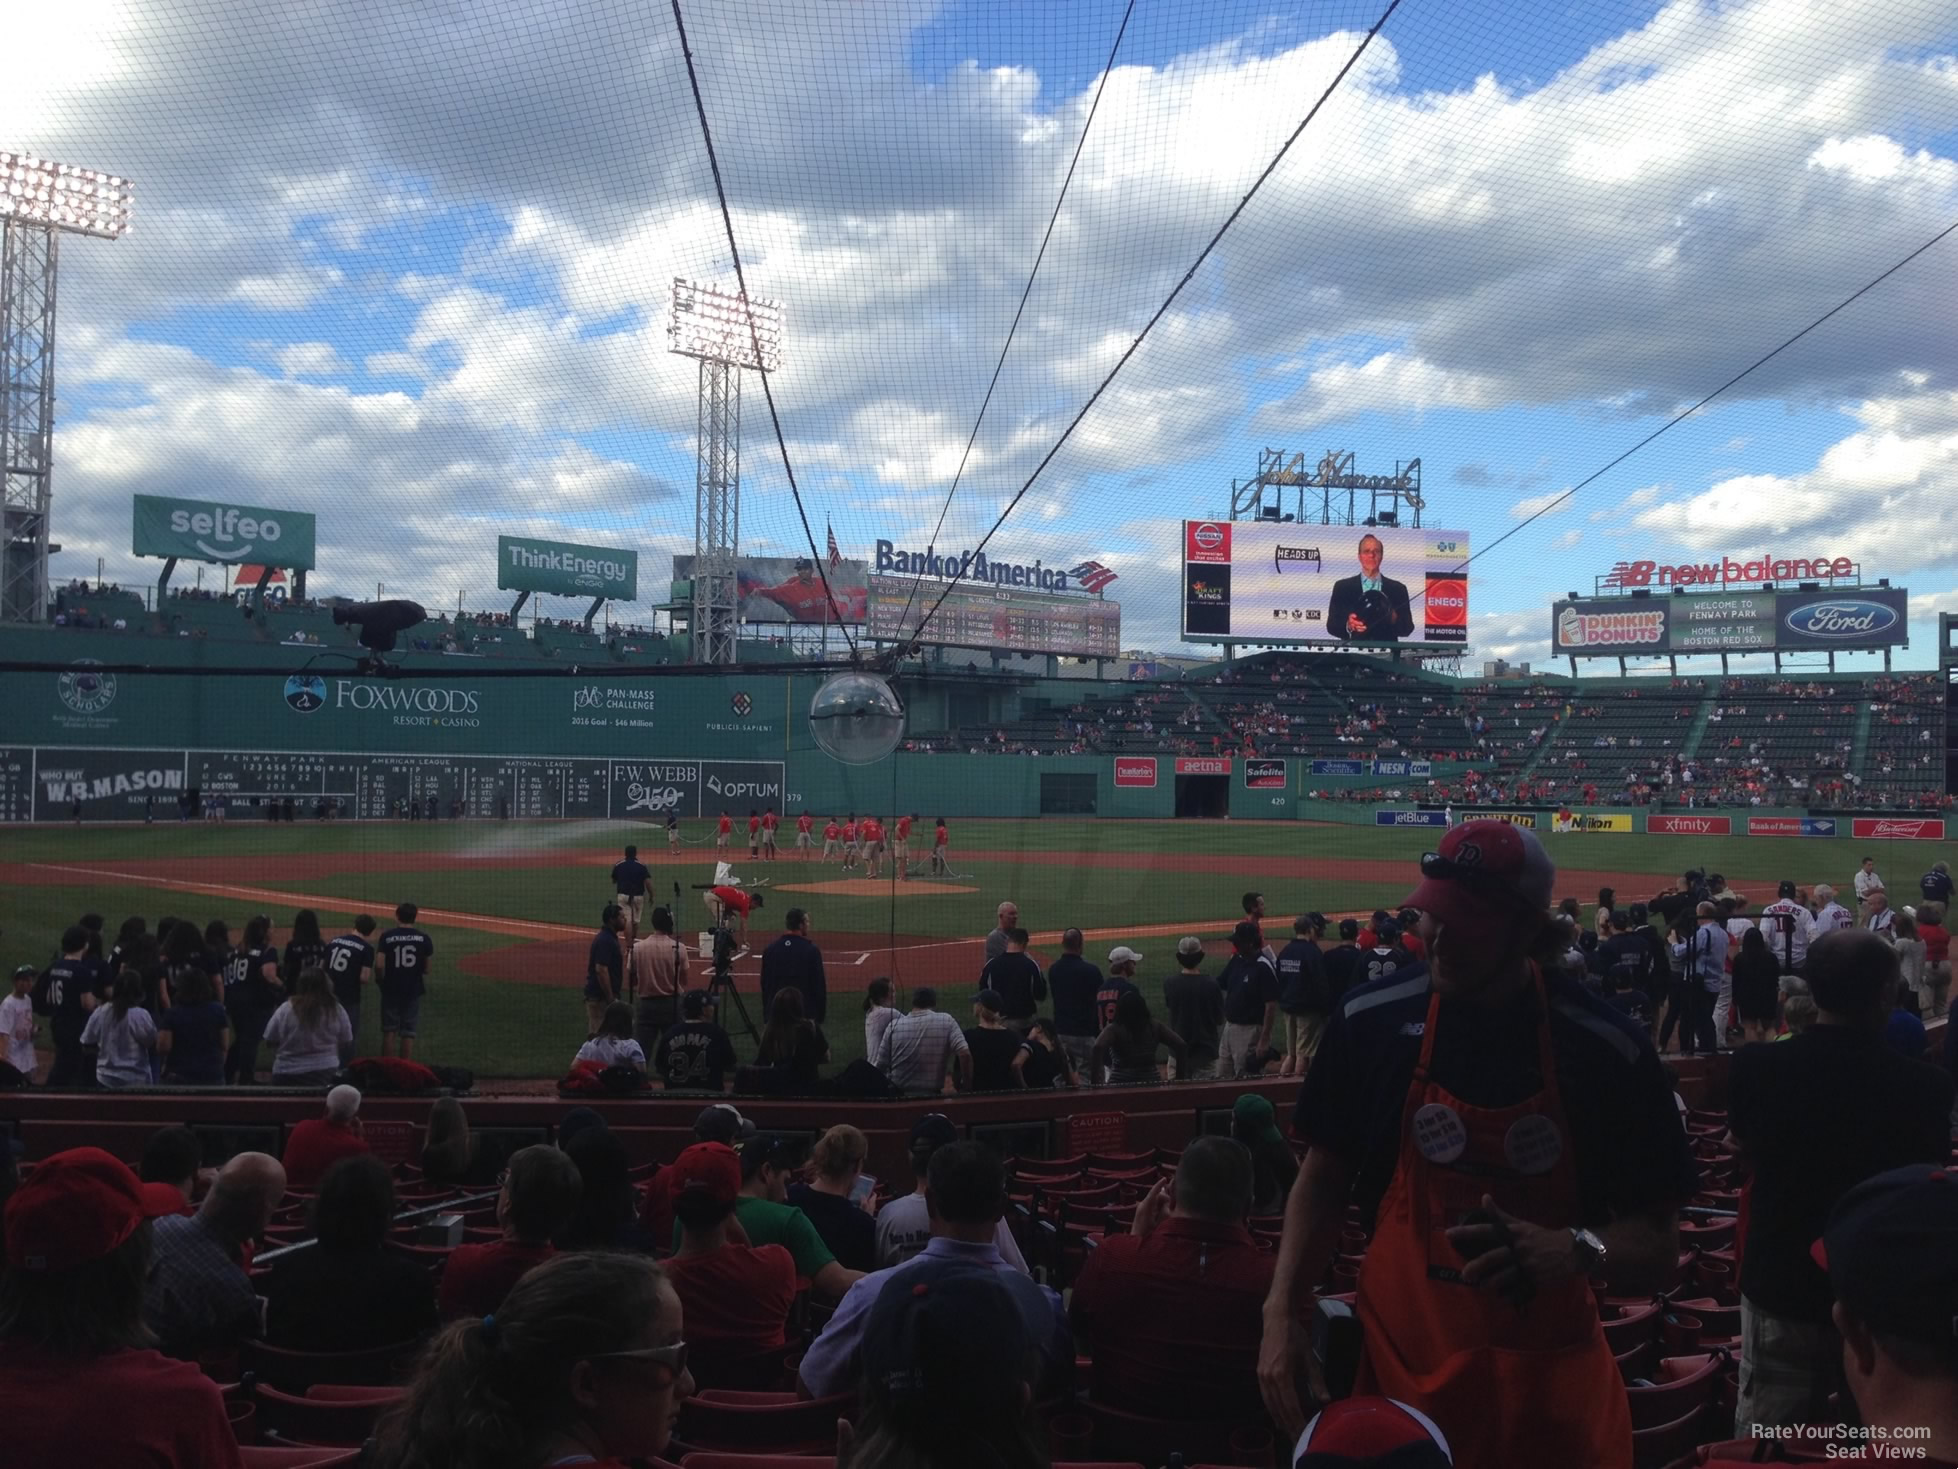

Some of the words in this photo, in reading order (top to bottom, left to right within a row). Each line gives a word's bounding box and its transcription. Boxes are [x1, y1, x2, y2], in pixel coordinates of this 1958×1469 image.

[1277, 549, 1306, 559] HEADS
[1308, 550, 1319, 559] UP
[508, 546, 626, 581] ThinkEnergy
[876, 539, 941, 578] Bank
[944, 550, 971, 580] of
[973, 551, 1067, 591] America
[1659, 563, 1719, 586] new
[1723, 554, 1852, 582] balance
[1427, 597, 1464, 607] ENEOS
[1694, 601, 1738, 610] WELCOME
[1741, 600, 1753, 608] TO
[1306, 610, 1320, 619] CDC
[1689, 610, 1728, 620] FENWAY
[1731, 609, 1757, 618] PARK
[1808, 605, 1876, 632] Ford
[1588, 612, 1663, 630] DUNKIN'
[1588, 627, 1659, 643] DONUTS
[1691, 627, 1716, 635] HOME
[1720, 626, 1733, 635] OF
[1735, 626, 1755, 634] THE
[1684, 637, 1720, 645] BOSTON
[1723, 636, 1741, 644] RED
[1744, 636, 1762, 644] SOX
[607, 689, 655, 700] PAN-MASS
[606, 700, 654, 710] CHALLENGE
[393, 716, 431, 726] RESORT
[441, 718, 480, 727] CASINO
[571, 717, 590, 726] 2016
[591, 717, 607, 726] Goal
[630, 720, 654, 728] Million
[706, 723, 740, 731] PUBLICIS
[742, 724, 773, 732] SAPIENT
[224, 755, 280, 763] FENWAY
[1184, 761, 1222, 772] aetna
[1247, 768, 1284, 776] Safelite
[1379, 763, 1405, 774] NESN
[614, 766, 644, 782] F.W.
[649, 766, 697, 782] WEBB
[211, 782, 239, 790] BOSTON
[724, 783, 778, 797] OPTUM
[1394, 813, 1430, 825] jetBlue
[1511, 815, 1534, 827] CITY
[1572, 816, 1612, 829] Nikon
[1666, 819, 1710, 833] xfinity
[1750, 822, 1768, 830] Bank
[1770, 822, 1778, 830] of
[1779, 823, 1811, 831] America
[1876, 824, 1921, 833] Budweiser
[1768, 905, 1801, 916] SANDERS
[330, 947, 351, 972] 16
[394, 945, 416, 968] 16
[668, 1050, 711, 1083] 34
[1071, 1116, 1124, 1128] CAUTION!
[905, 1232, 914, 1243] to
